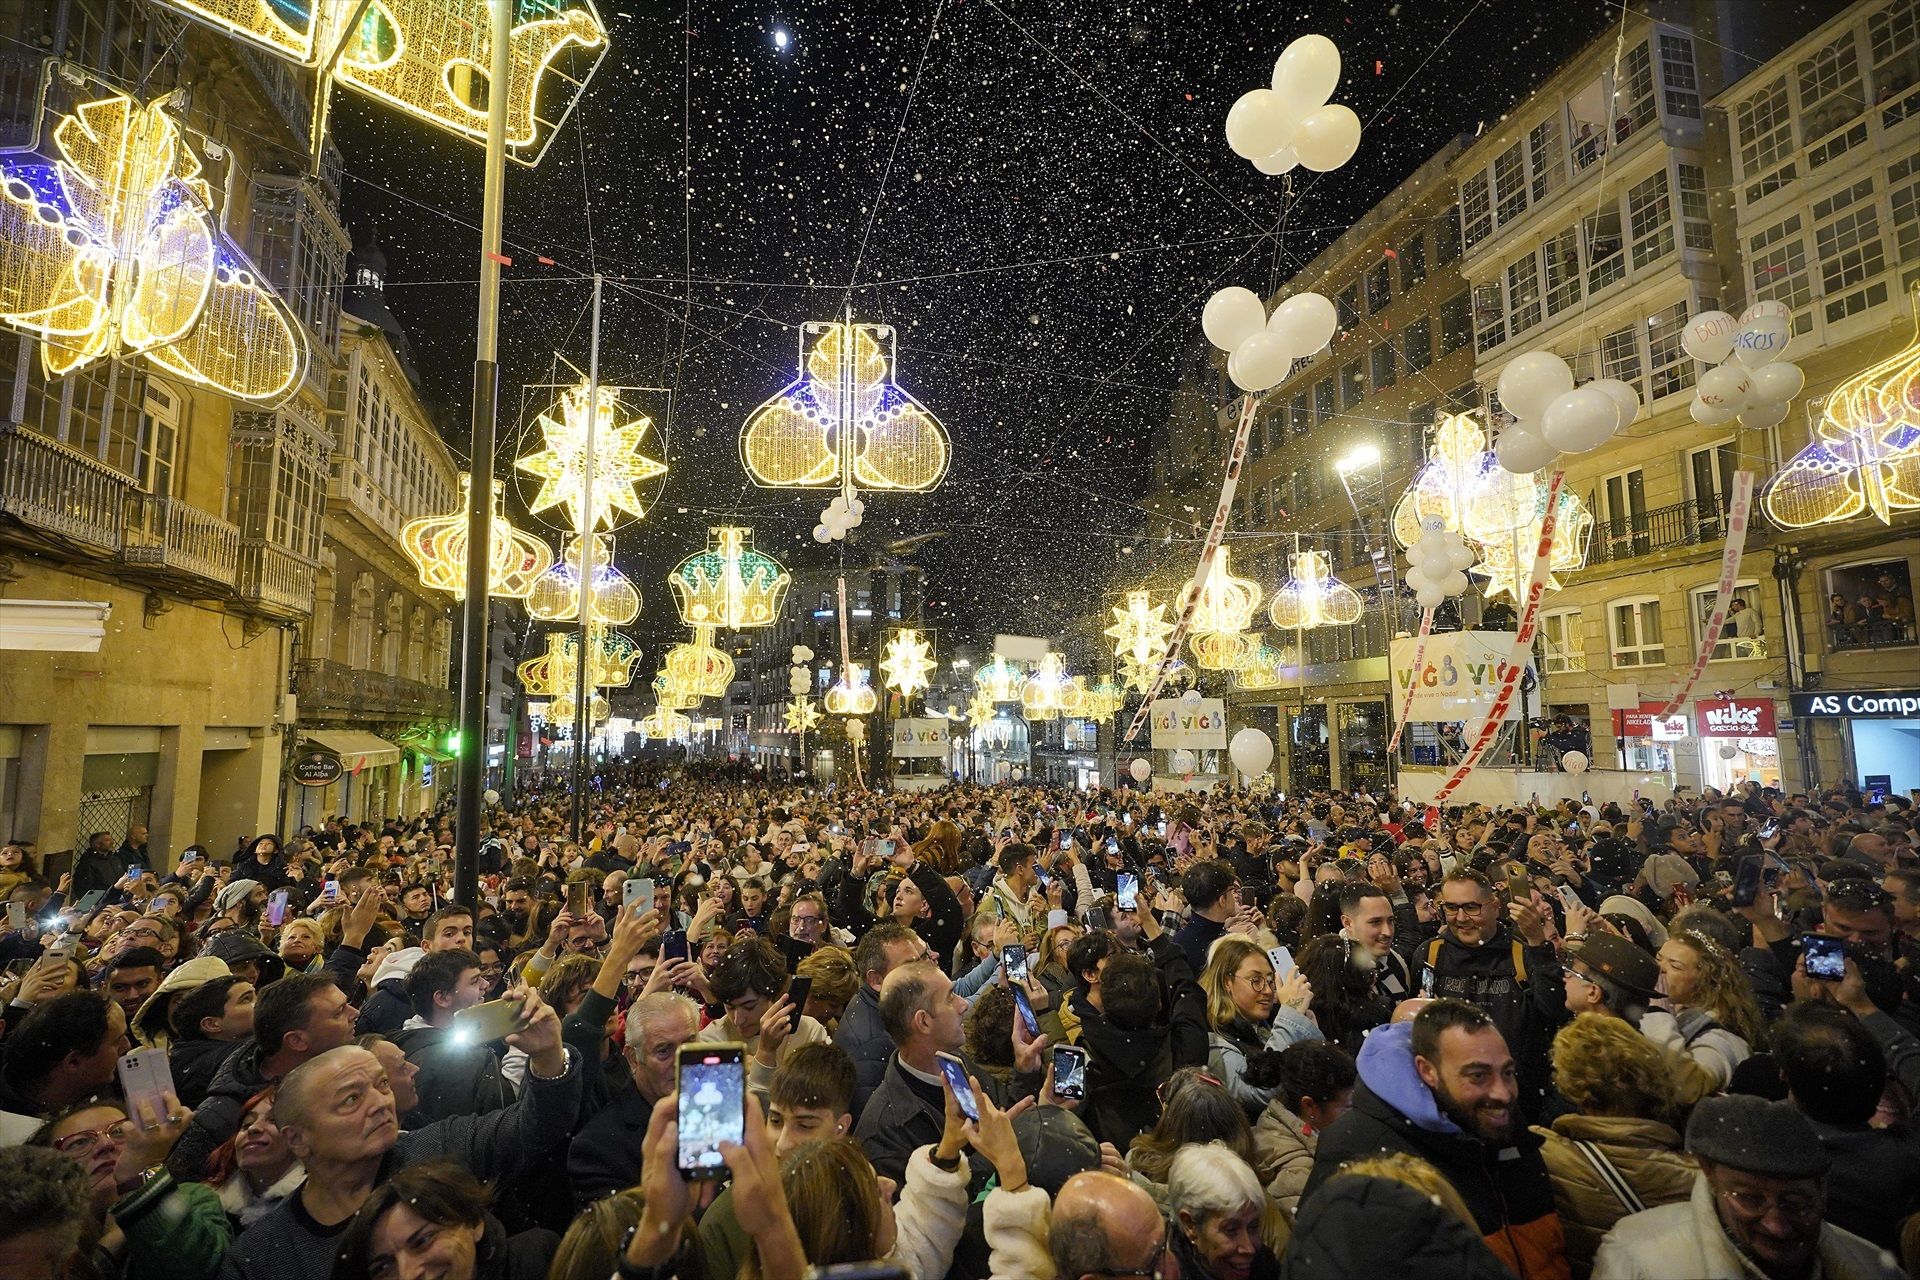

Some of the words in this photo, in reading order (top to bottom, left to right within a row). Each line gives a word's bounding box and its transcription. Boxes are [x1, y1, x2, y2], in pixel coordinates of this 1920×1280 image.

[1227, 397, 1257, 480] VIGO
[1202, 504, 1228, 563] SEN
[1537, 471, 1565, 557] VIGO
[1516, 581, 1543, 643] SEN
[1124, 586, 1201, 740] BOMBEIROS
[1434, 665, 1522, 800] BOMBEIROS
[1706, 702, 1758, 725] Nikis
[1810, 696, 1841, 714] AS
[1847, 695, 1920, 716] Comp
